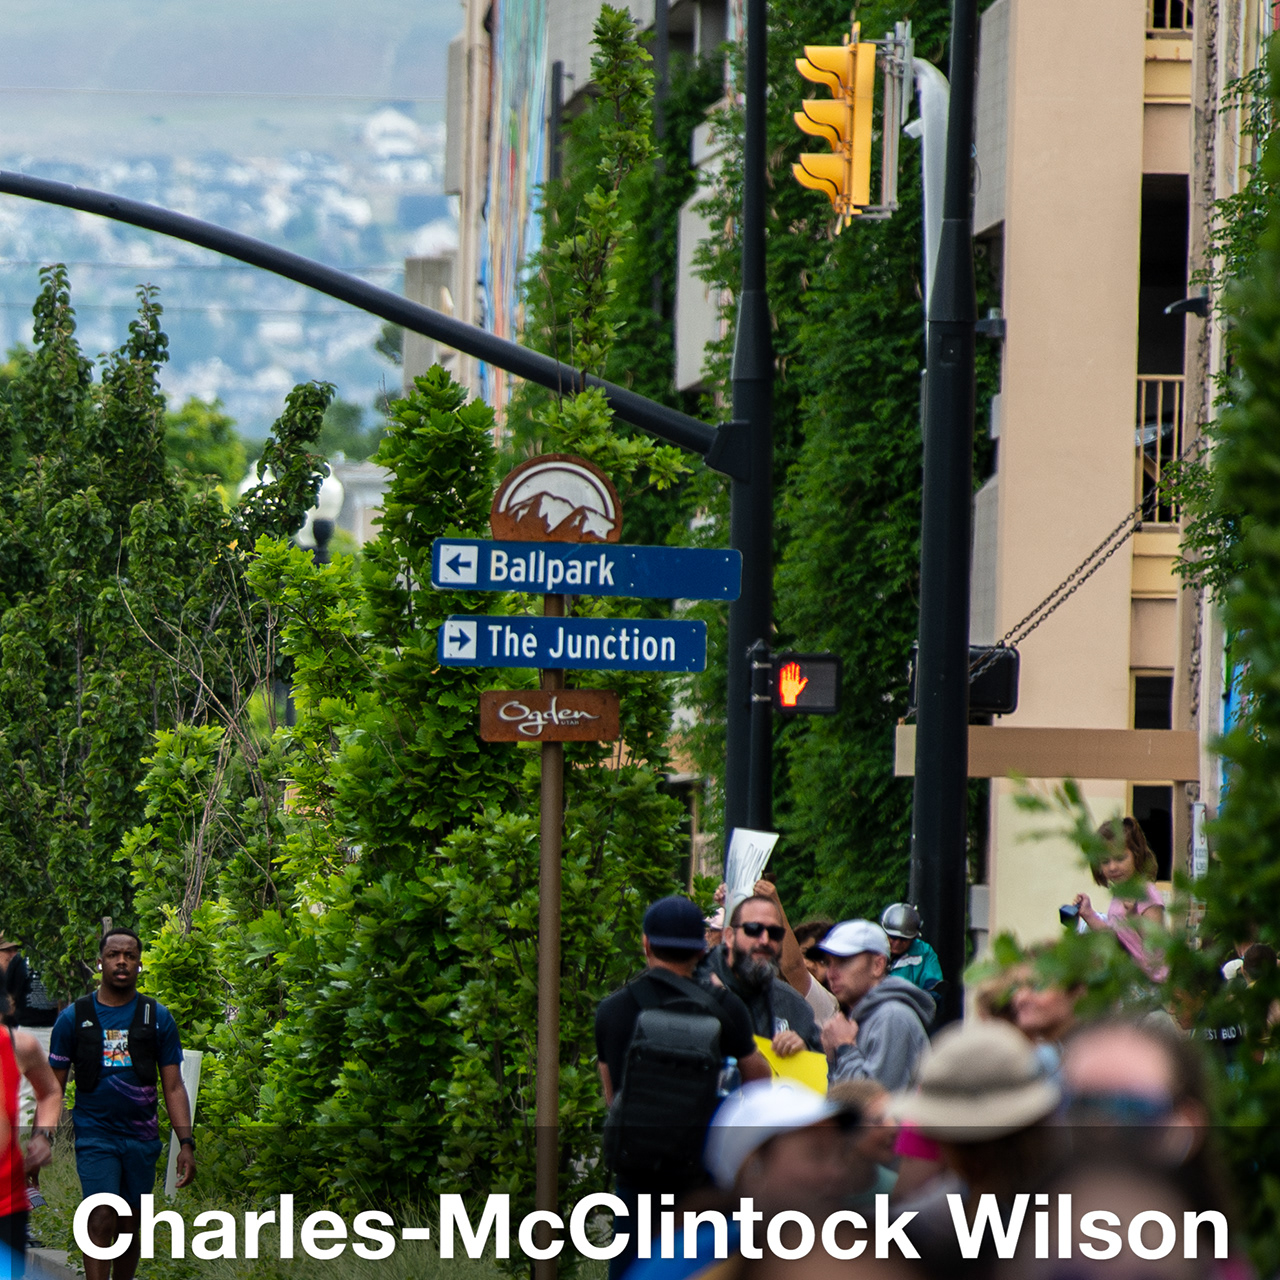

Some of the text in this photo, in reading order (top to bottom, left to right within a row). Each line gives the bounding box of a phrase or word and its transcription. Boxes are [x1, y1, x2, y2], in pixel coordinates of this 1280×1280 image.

[489, 548, 616, 591] Ballpark
[487, 624, 677, 663] The Junction
[497, 695, 601, 737] Ogden
